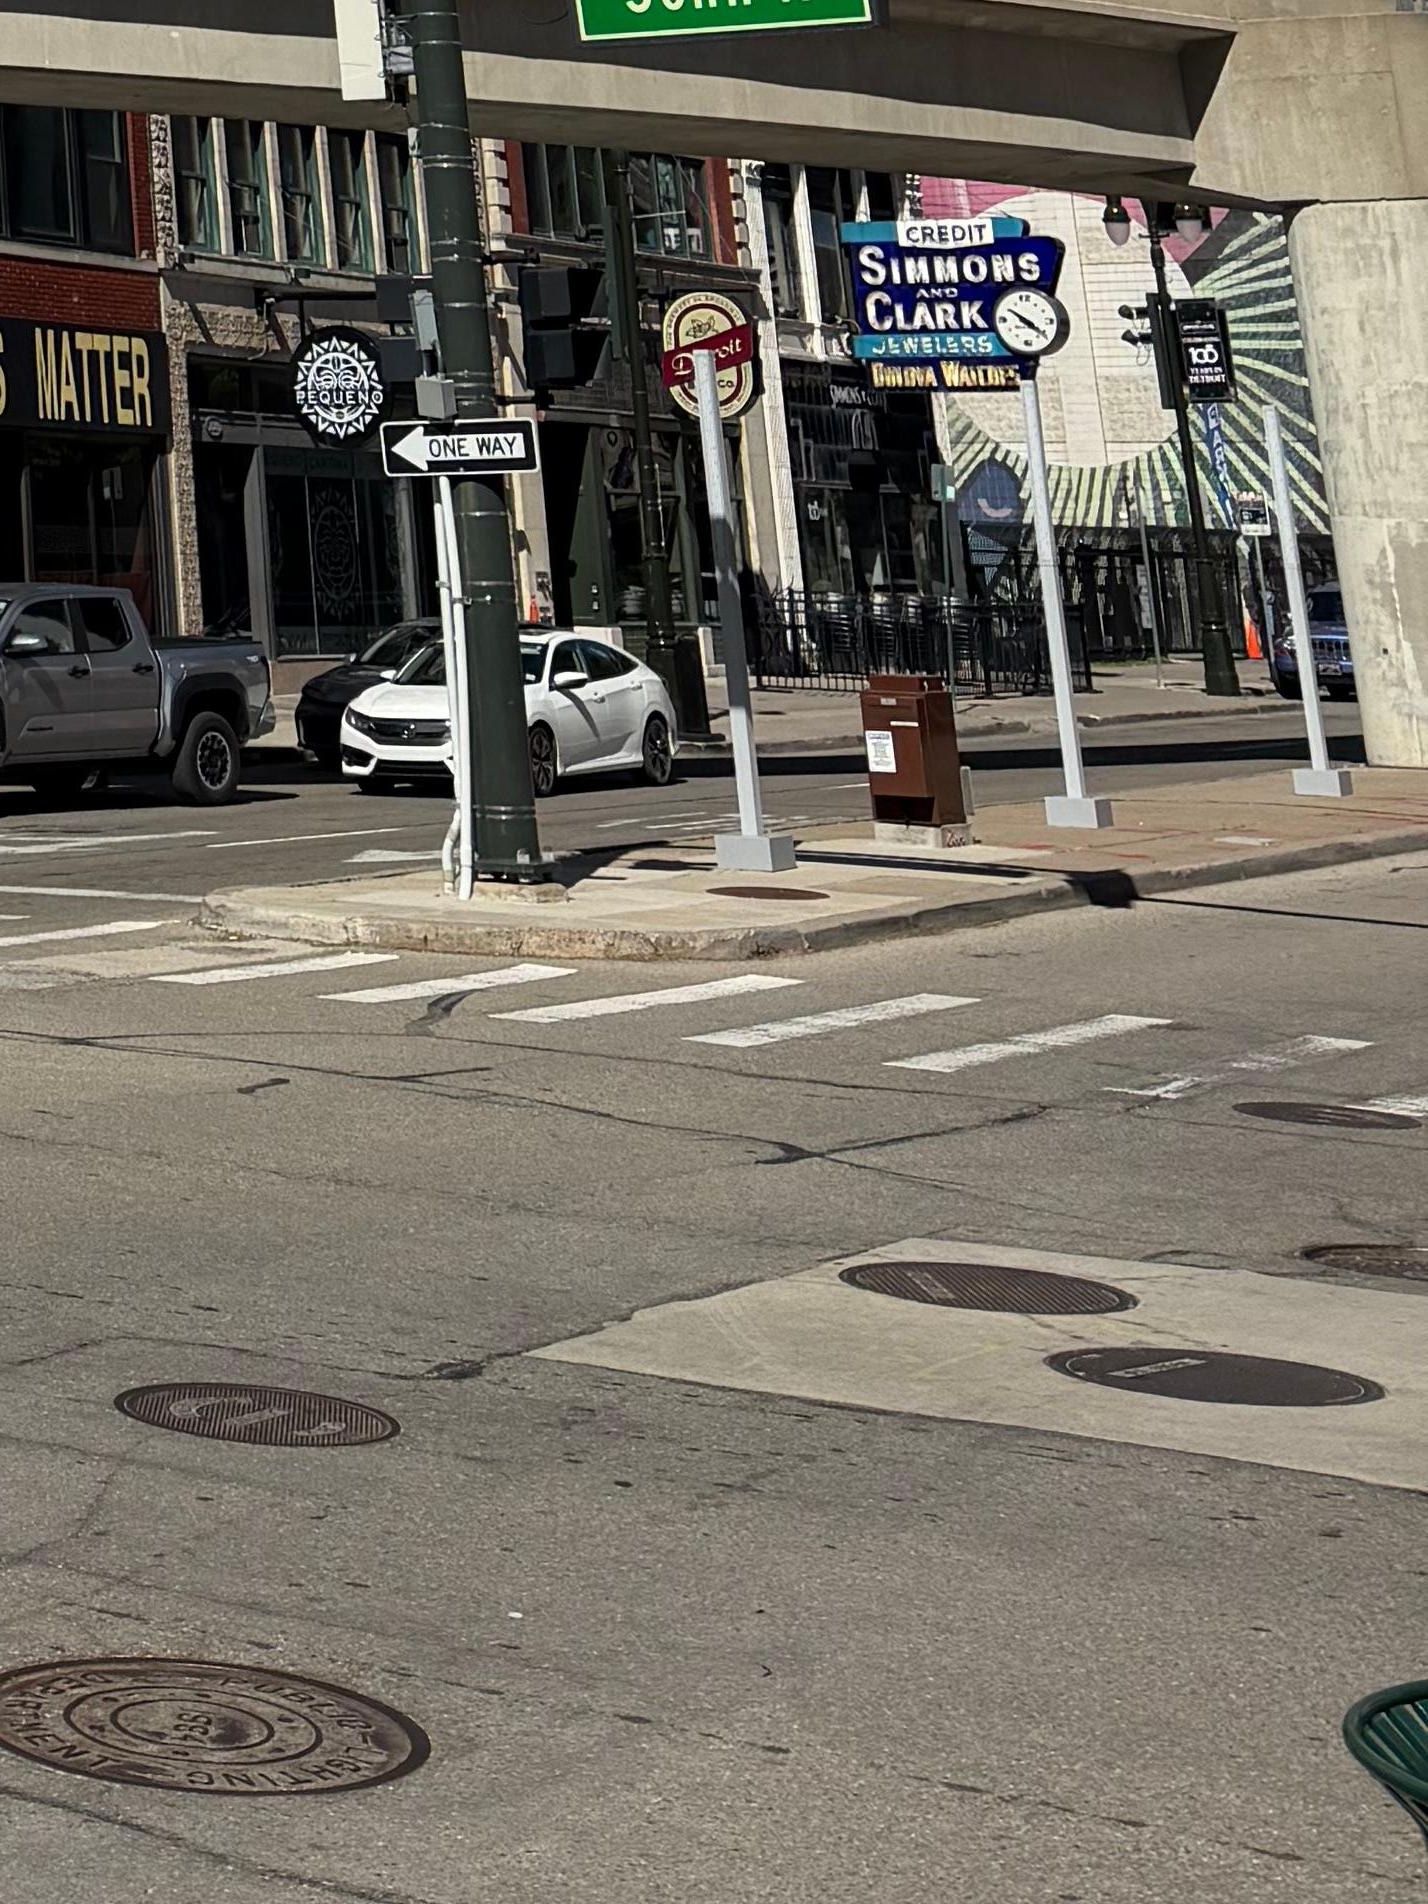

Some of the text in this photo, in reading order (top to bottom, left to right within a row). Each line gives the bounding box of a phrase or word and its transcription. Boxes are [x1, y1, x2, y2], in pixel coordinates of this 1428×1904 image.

[906, 223, 987, 243] CREDIT
[858, 245, 1041, 286] SIMMONS
[916, 287, 959, 299] AND
[865, 290, 989, 331] CLARK
[872, 335, 993, 355] JEWELERS
[34, 327, 152, 427] MATTER
[296, 390, 384, 405] PEQUENO
[429, 436, 518, 458] ONE WAY
